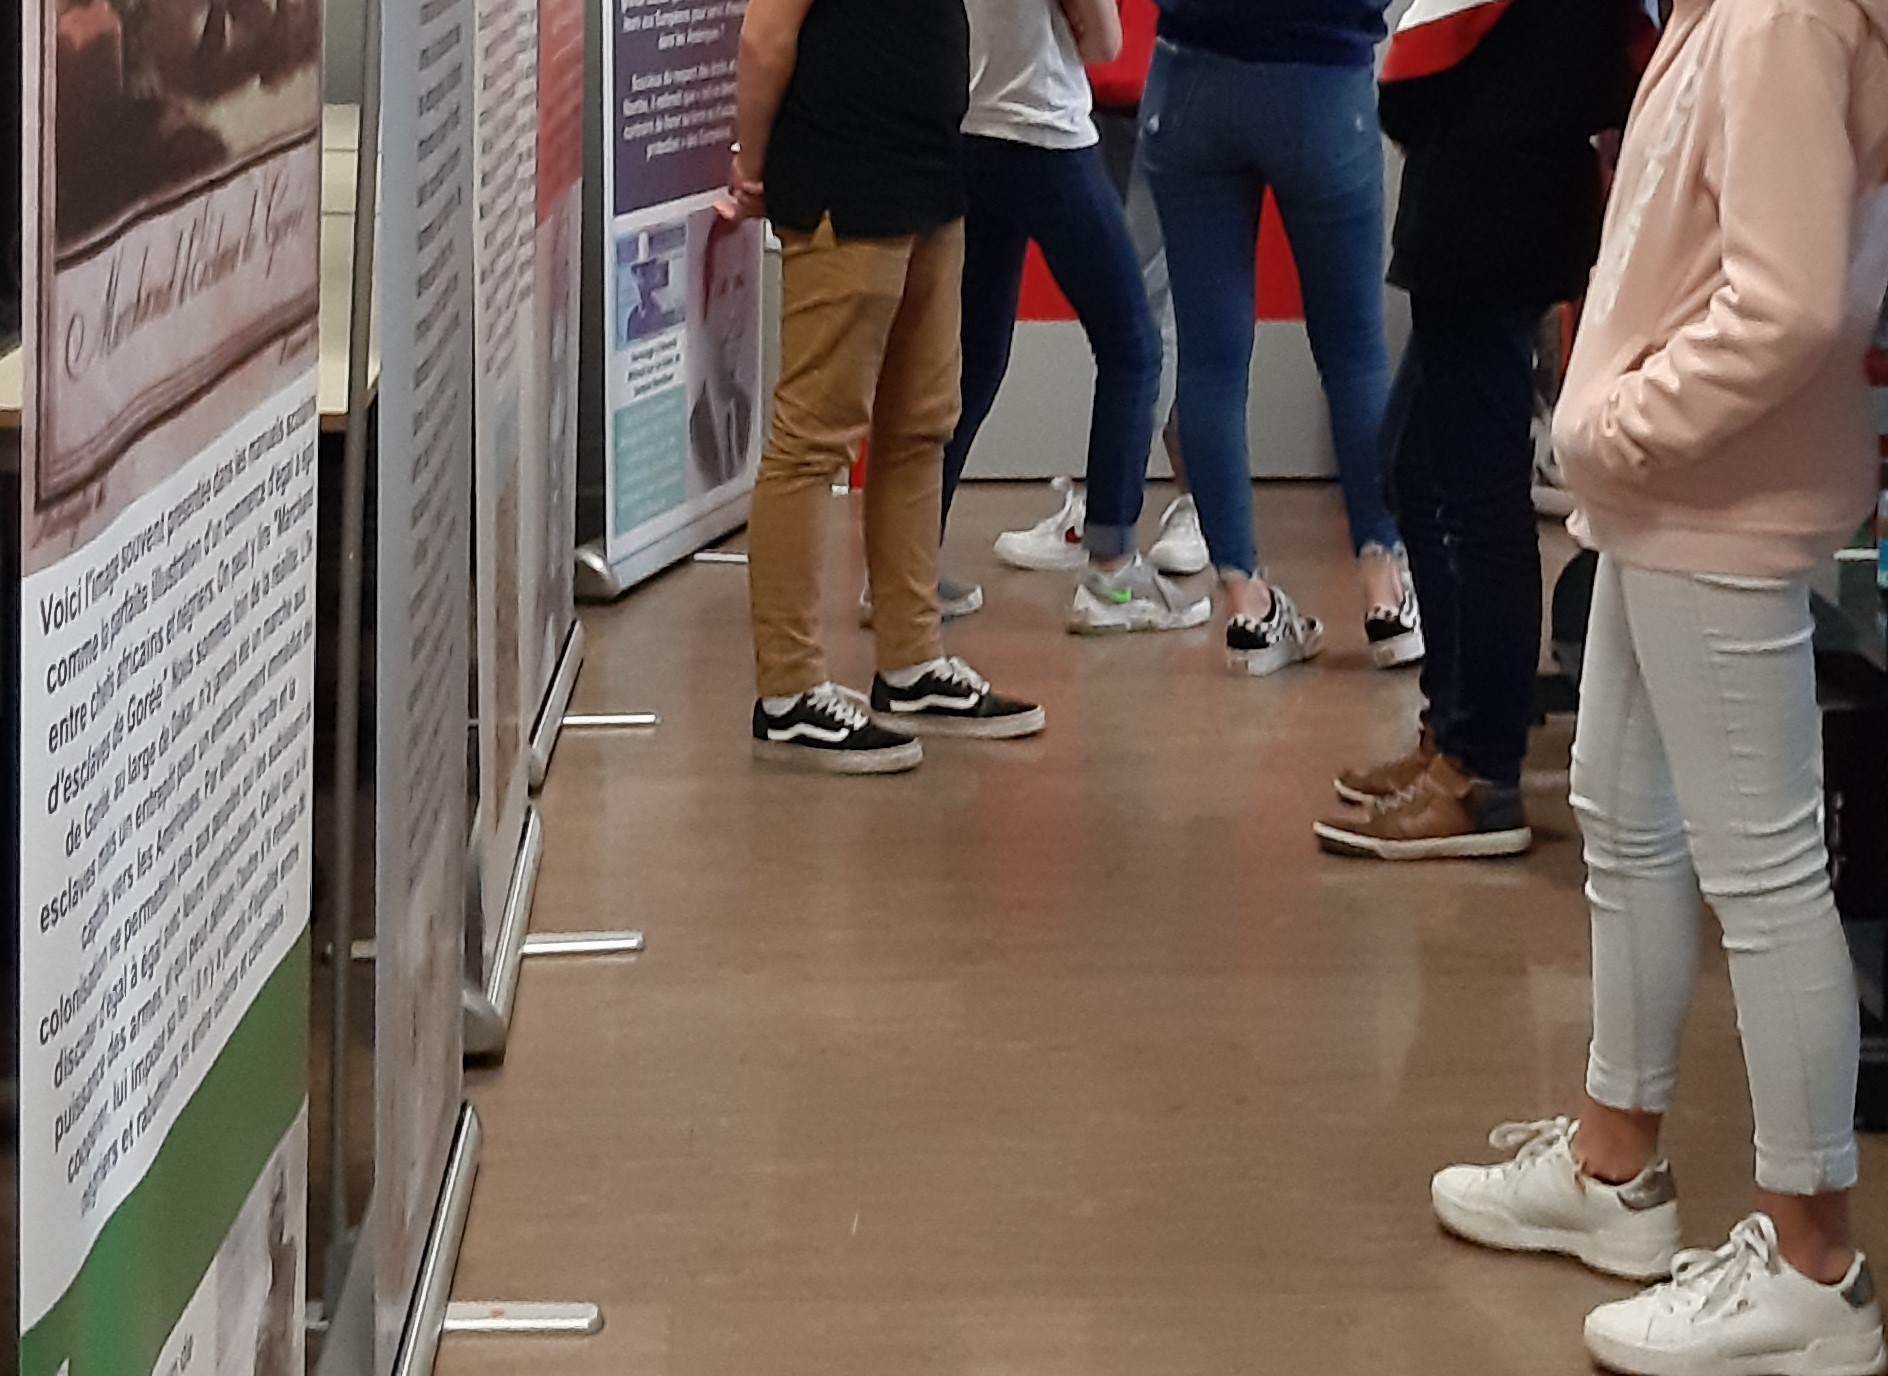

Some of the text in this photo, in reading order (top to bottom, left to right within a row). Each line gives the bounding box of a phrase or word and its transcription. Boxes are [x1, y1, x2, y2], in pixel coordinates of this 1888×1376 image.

[39, 578, 83, 638] Voici
[48, 703, 89, 756] entre
[65, 820, 83, 859] de
